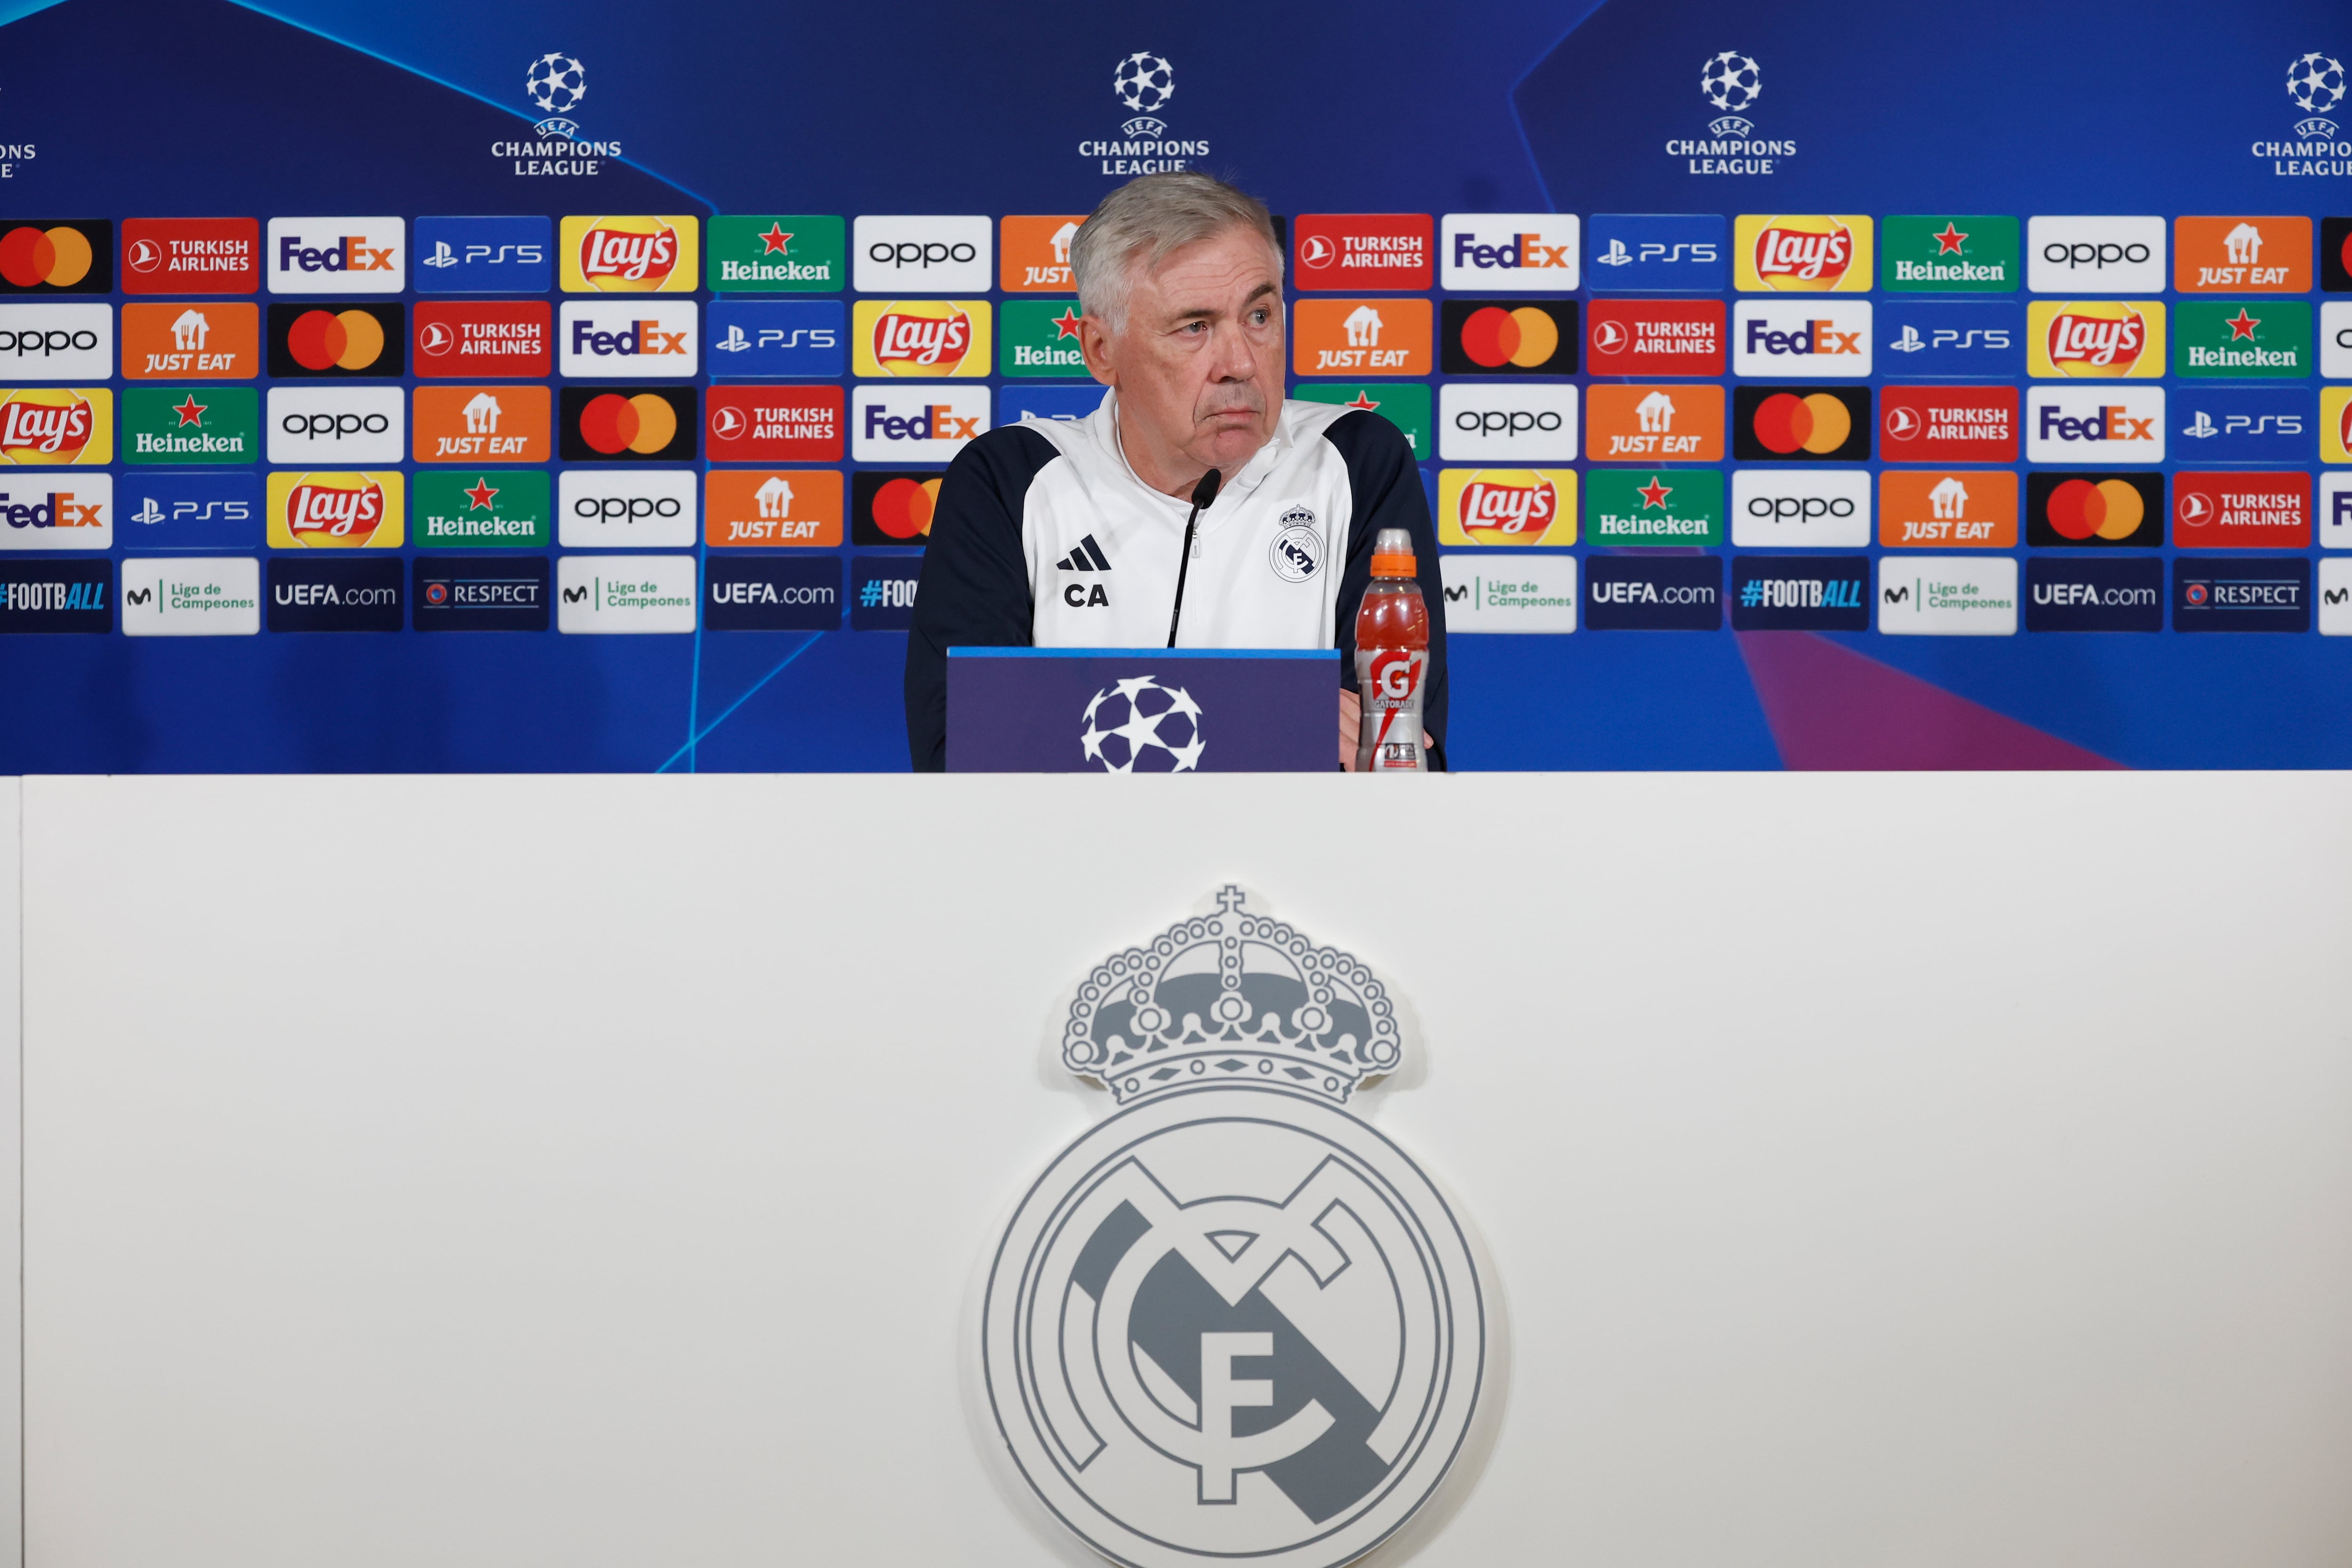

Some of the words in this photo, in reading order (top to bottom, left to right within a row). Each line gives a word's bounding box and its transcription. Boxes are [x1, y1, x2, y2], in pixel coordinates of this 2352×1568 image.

[536, 121, 574, 136] UEFA
[1123, 121, 1162, 136] UEFA
[1710, 120, 1750, 135] UEFA
[2296, 122, 2335, 137] UEFA
[492, 142, 621, 156] CHAMPIONS
[1079, 141, 1209, 156] CHAMPIONS
[1666, 140, 1796, 156] CHAMPIONS
[2252, 142, 2352, 157] CHAMPIO
[515, 161, 598, 175] LEAGUE
[1103, 160, 1186, 174] LEAGUE
[1689, 159, 1773, 174] LEAGUE
[170, 240, 247, 254] TURKISH
[1343, 237, 1422, 251] TURKISH
[1454, 233, 1568, 269] FedEx
[1640, 244, 1716, 262] PS5
[280, 237, 394, 272] FedEx
[466, 245, 542, 263] PS5
[586, 231, 671, 280] Lay's
[870, 243, 976, 269] oppo
[1342, 253, 1423, 267] AIRLINES
[1760, 230, 1845, 280] Lay's
[2044, 244, 2150, 269] oppo
[169, 257, 248, 271] AIRLINES
[722, 261, 830, 280] Heineken
[1896, 261, 2004, 280] Heineken
[1024, 267, 1071, 285] JUST
[2197, 268, 2247, 286] JUST
[2250, 268, 2289, 284] EAT
[461, 324, 540, 338] TURKISH
[573, 320, 686, 356] FedEx
[1636, 323, 1715, 336] TURKISH
[1747, 320, 1860, 355] FedEx
[461, 340, 541, 354] AIRLINES
[759, 330, 835, 348] PS5
[879, 316, 964, 365] Lay's
[1634, 339, 1716, 353] AIRLINES
[1933, 330, 2010, 348] PS5
[2054, 317, 2138, 366] Lay's
[145, 354, 193, 373] JUST
[198, 354, 235, 370] EAT
[1014, 346, 1085, 365] Heine
[1317, 350, 1367, 369] JUST
[1370, 350, 1409, 366] EAT
[2189, 347, 2297, 366] Heineken
[754, 408, 833, 422] TURKISH
[866, 405, 979, 440] FedEx
[1929, 409, 2008, 423] TURKISH
[2040, 406, 2153, 441] FedEx
[2, 403, 87, 453] Lay's
[283, 414, 389, 440] oppo
[753, 425, 834, 438] AIRLINES
[1456, 412, 1562, 437] oppo
[1927, 425, 2009, 439] AIRLINES
[2225, 416, 2302, 434] PS5
[136, 433, 243, 452] Heineken
[436, 437, 485, 456] JUST
[489, 437, 527, 453] EAT
[1609, 436, 1659, 454] JUST
[1662, 436, 1701, 452] EAT
[1465, 484, 1550, 534] Lay's
[2222, 494, 2300, 508] TURKISH
[174, 502, 249, 520] PS5
[293, 486, 378, 536] Lay's
[575, 498, 680, 523] oppo
[1748, 498, 1854, 523] oppo
[2220, 511, 2301, 525] AIRLINES
[428, 516, 535, 535] Heineken
[728, 522, 778, 540] JUST
[781, 522, 820, 538] EAT
[1600, 515, 1708, 534] Heineken
[1902, 522, 1952, 541] JUST
[1955, 522, 1994, 539] EAT
[172, 583, 199, 597] Liga
[204, 584, 221, 594] de
[276, 585, 395, 605] UEFA.com
[455, 586, 538, 602] RESPECT
[608, 581, 636, 595] Liga
[640, 582, 657, 593] de
[713, 583, 834, 603] UEFA.com
[1064, 584, 1109, 607] CA
[1489, 580, 1517, 595] Liga
[1521, 582, 1538, 592] de
[1593, 582, 1714, 603] UEFA.com
[1741, 580, 1860, 607] #FOOTBALL
[1930, 583, 1957, 596] Liga
[1962, 584, 1979, 594] de
[2034, 584, 2155, 605] UEFA.com
[2215, 586, 2299, 603] RESPECT
[172, 596, 254, 611] Campeones
[607, 594, 691, 609] Campeones
[1488, 594, 1571, 609] Campeones
[1929, 595, 2012, 611] Campeones
[1381, 660, 1410, 699] G
[1375, 700, 1414, 709] GATORADE
